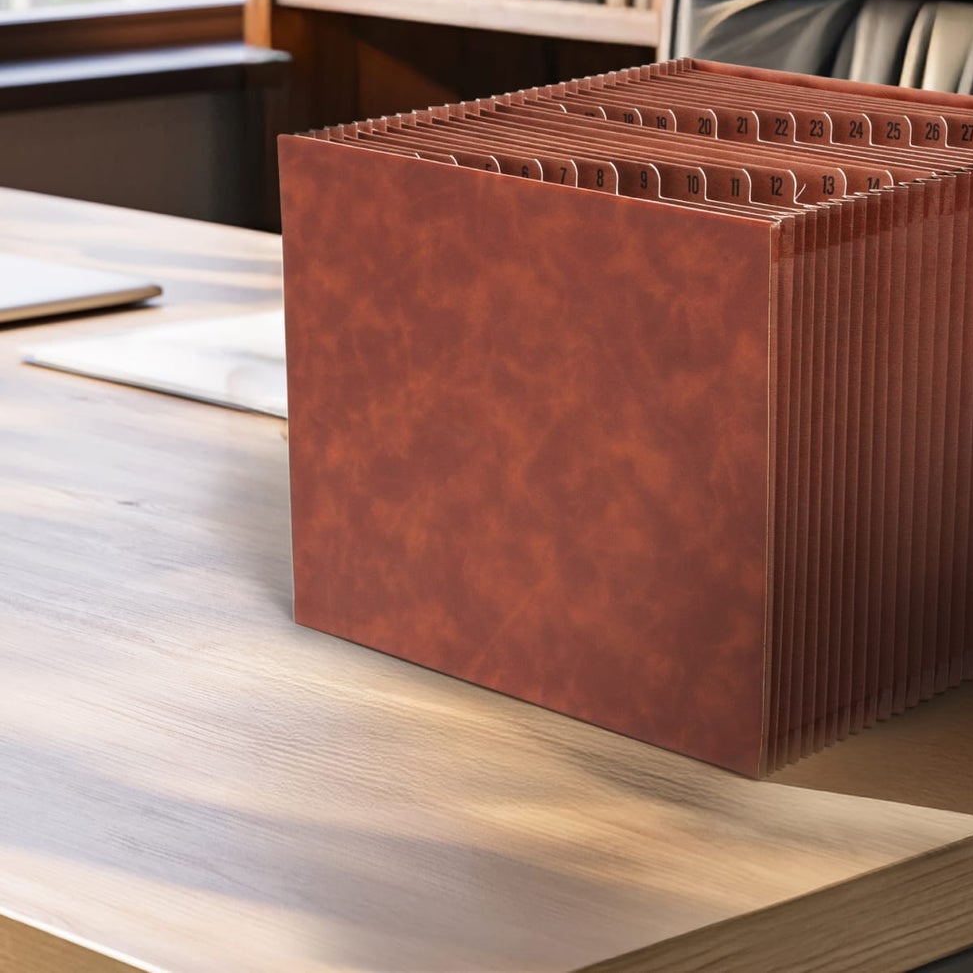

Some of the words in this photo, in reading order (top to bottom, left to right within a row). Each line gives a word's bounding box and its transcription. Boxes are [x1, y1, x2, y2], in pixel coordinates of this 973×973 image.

[656, 116, 667, 129] 19
[698, 118, 711, 135] 20
[737, 117, 748, 134] 21
[775, 118, 788, 137] 22
[810, 119, 824, 138] 23
[850, 121, 863, 139] 24
[887, 121, 900, 140] 25
[925, 122, 940, 141] 26
[560, 167, 567, 184] 7
[596, 169, 604, 187] 8
[640, 170, 648, 189] 9
[686, 175, 699, 194] 10
[730, 177, 740, 197] 11
[769, 175, 783, 196] 12
[821, 175, 835, 195] 13
[867, 177, 880, 190] 14
